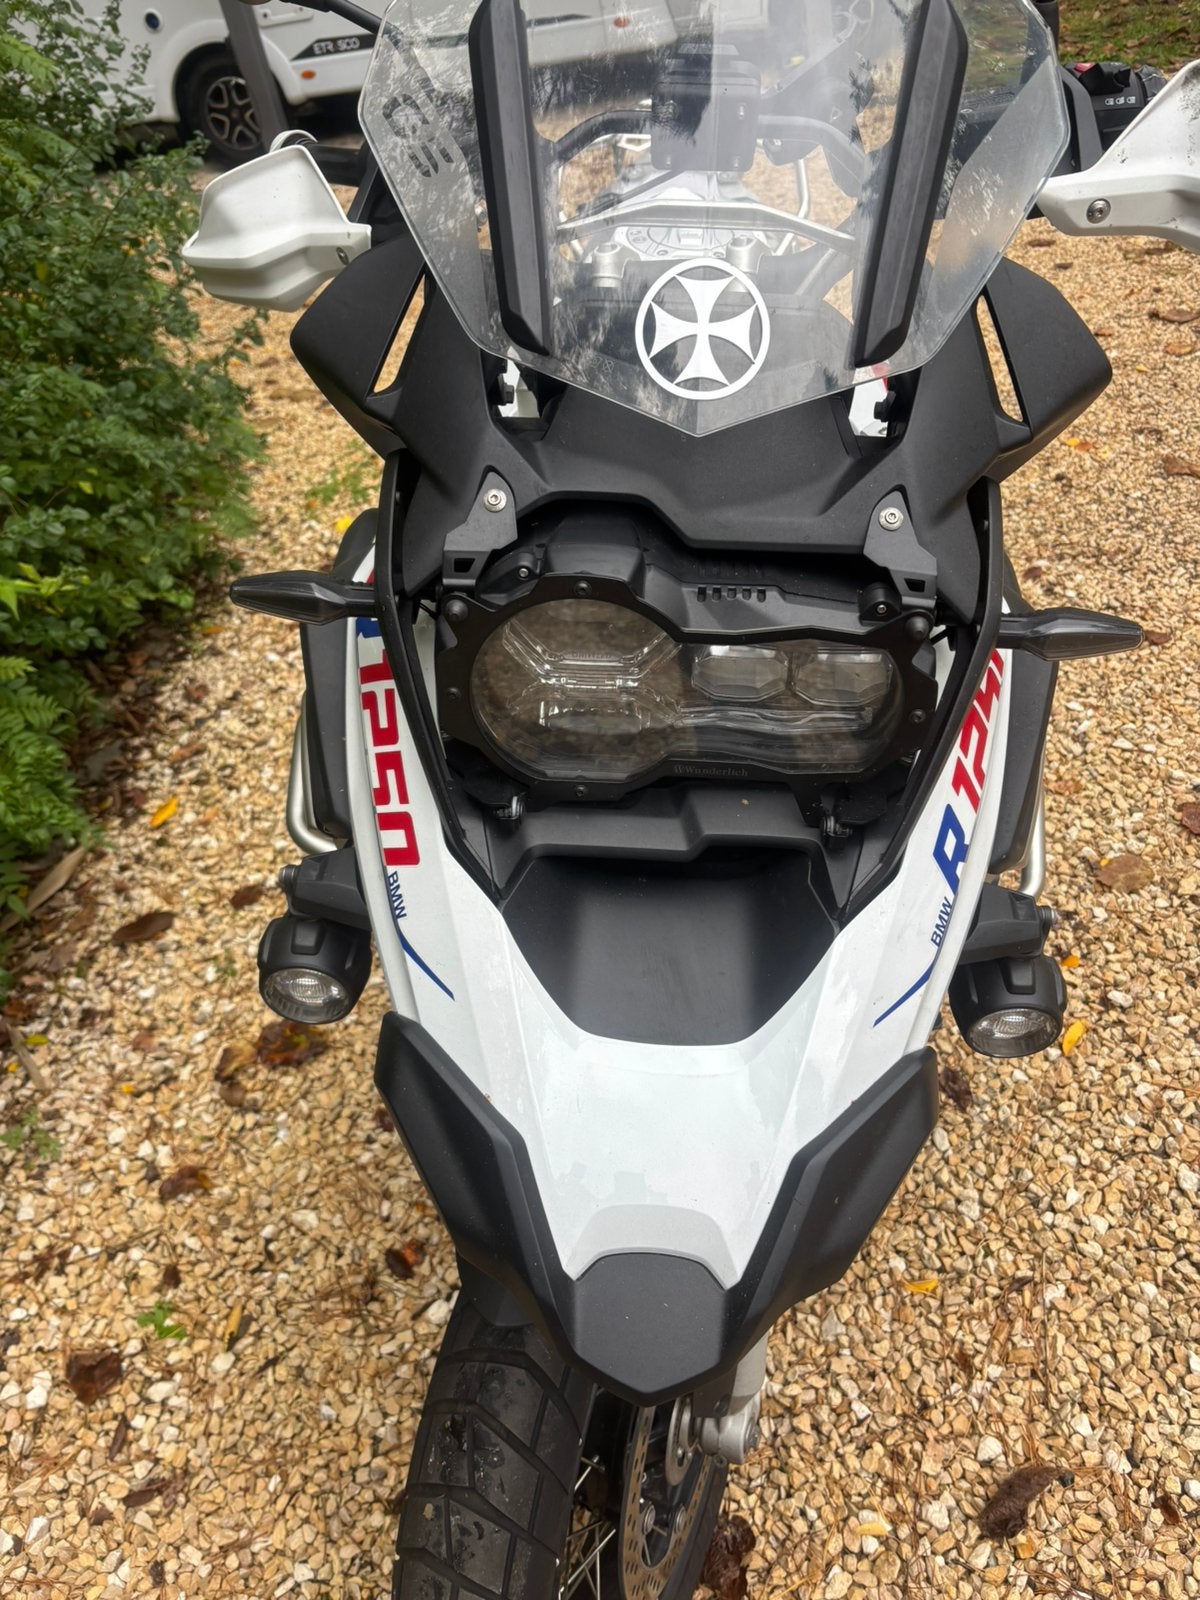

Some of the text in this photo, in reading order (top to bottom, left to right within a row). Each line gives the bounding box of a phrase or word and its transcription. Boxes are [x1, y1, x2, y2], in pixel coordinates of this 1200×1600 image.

[932, 803, 970, 896] R
[387, 870, 408, 920] BMW
[931, 896, 953, 947] BMW
